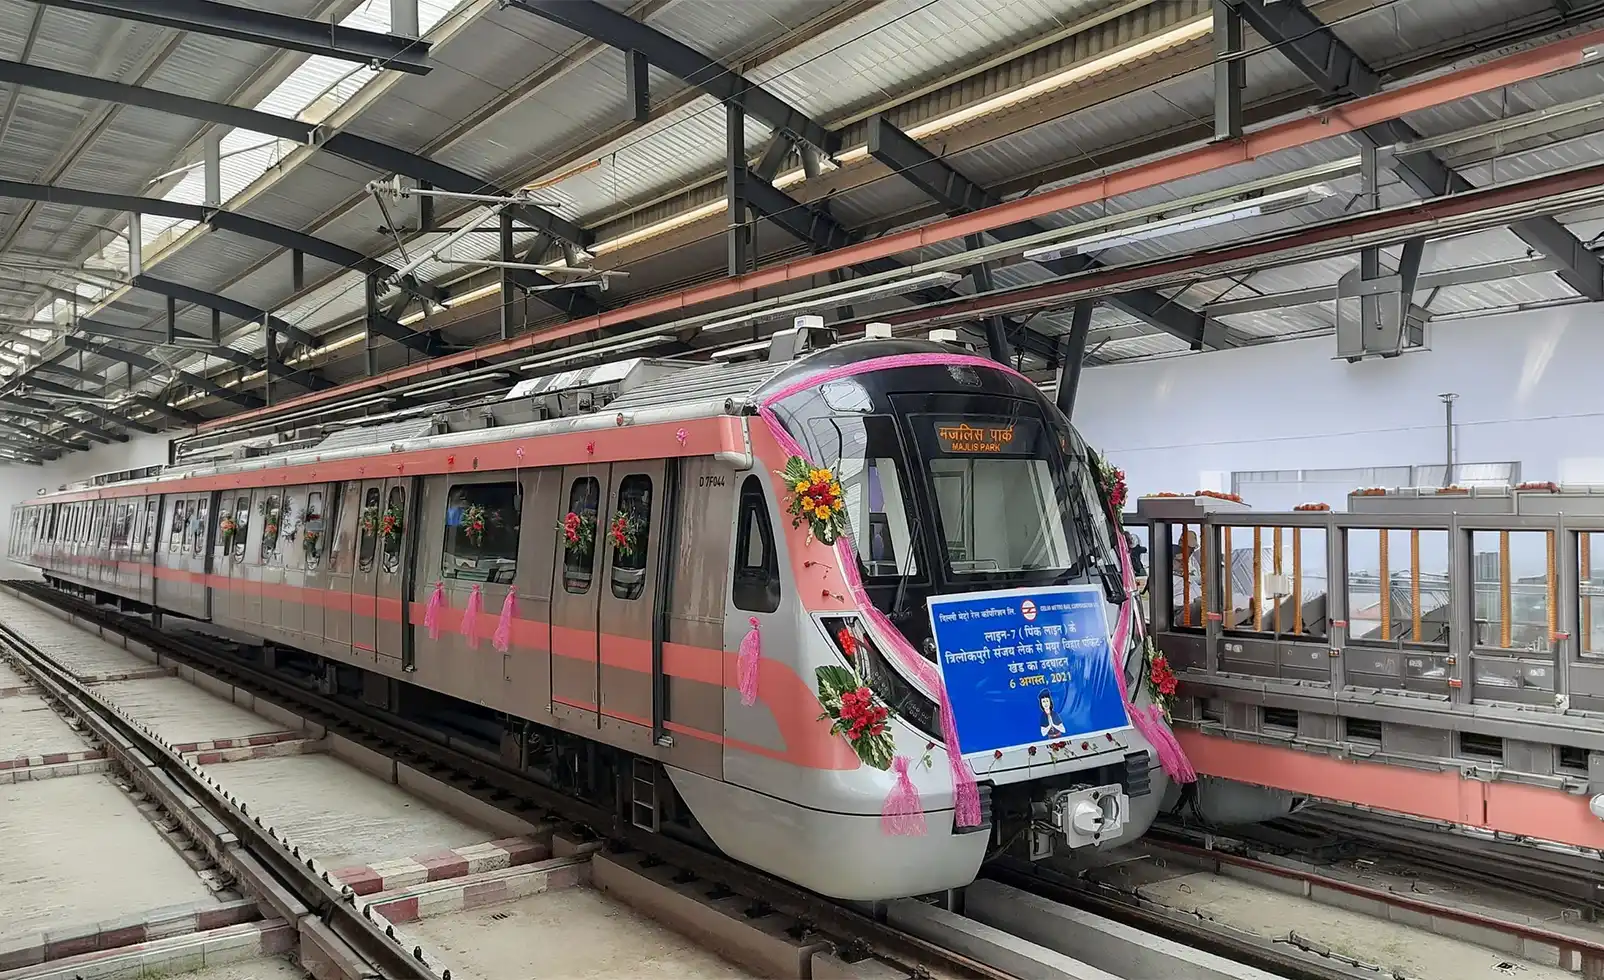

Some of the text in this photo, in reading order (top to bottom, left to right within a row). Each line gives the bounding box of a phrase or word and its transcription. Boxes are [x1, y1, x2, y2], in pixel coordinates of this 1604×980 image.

[939, 423, 1013, 441] मजलिस पार्क
[952, 443, 1000, 451] MAJLIS PARK
[984, 629, 1016, 643] लाइन-7
[1068, 621, 1077, 633] के
[945, 646, 991, 664] त्रिलोकपुरी
[993, 645, 1015, 658] संजय
[1017, 641, 1033, 655] लेक
[1035, 640, 1043, 653] से
[1044, 642, 1060, 654] मयूर
[1062, 637, 1080, 651] विहार
[1008, 661, 1025, 673] खंड
[1026, 660, 1039, 671] का
[1009, 679, 1016, 689] 6
[1050, 671, 1072, 683] 2021
